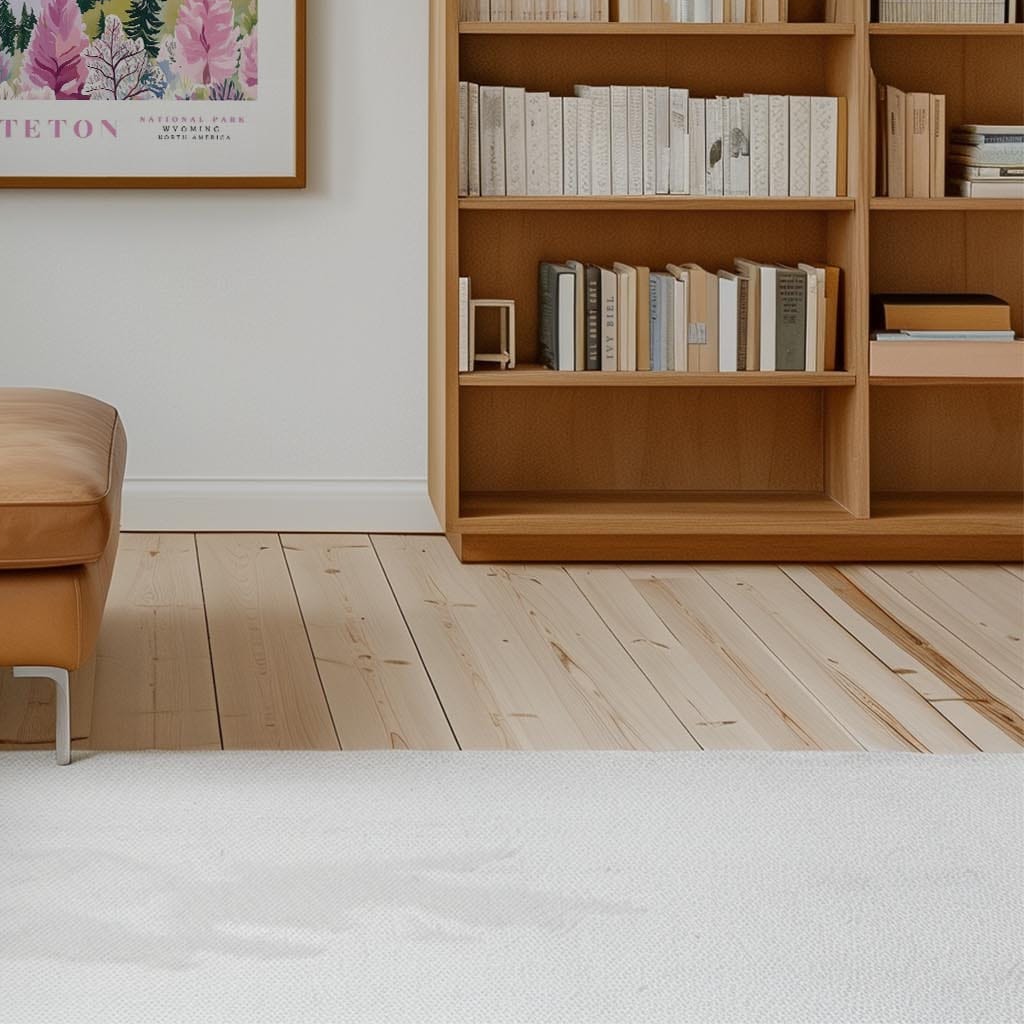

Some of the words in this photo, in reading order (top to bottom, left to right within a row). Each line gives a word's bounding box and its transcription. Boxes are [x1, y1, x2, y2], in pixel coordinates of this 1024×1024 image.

[162, 125, 220, 133] WYOMING
[606, 296, 614, 327] BIEL
[589, 310, 597, 338] ABOUT
[589, 344, 597, 361] ALL
[606, 335, 614, 359] IVY
